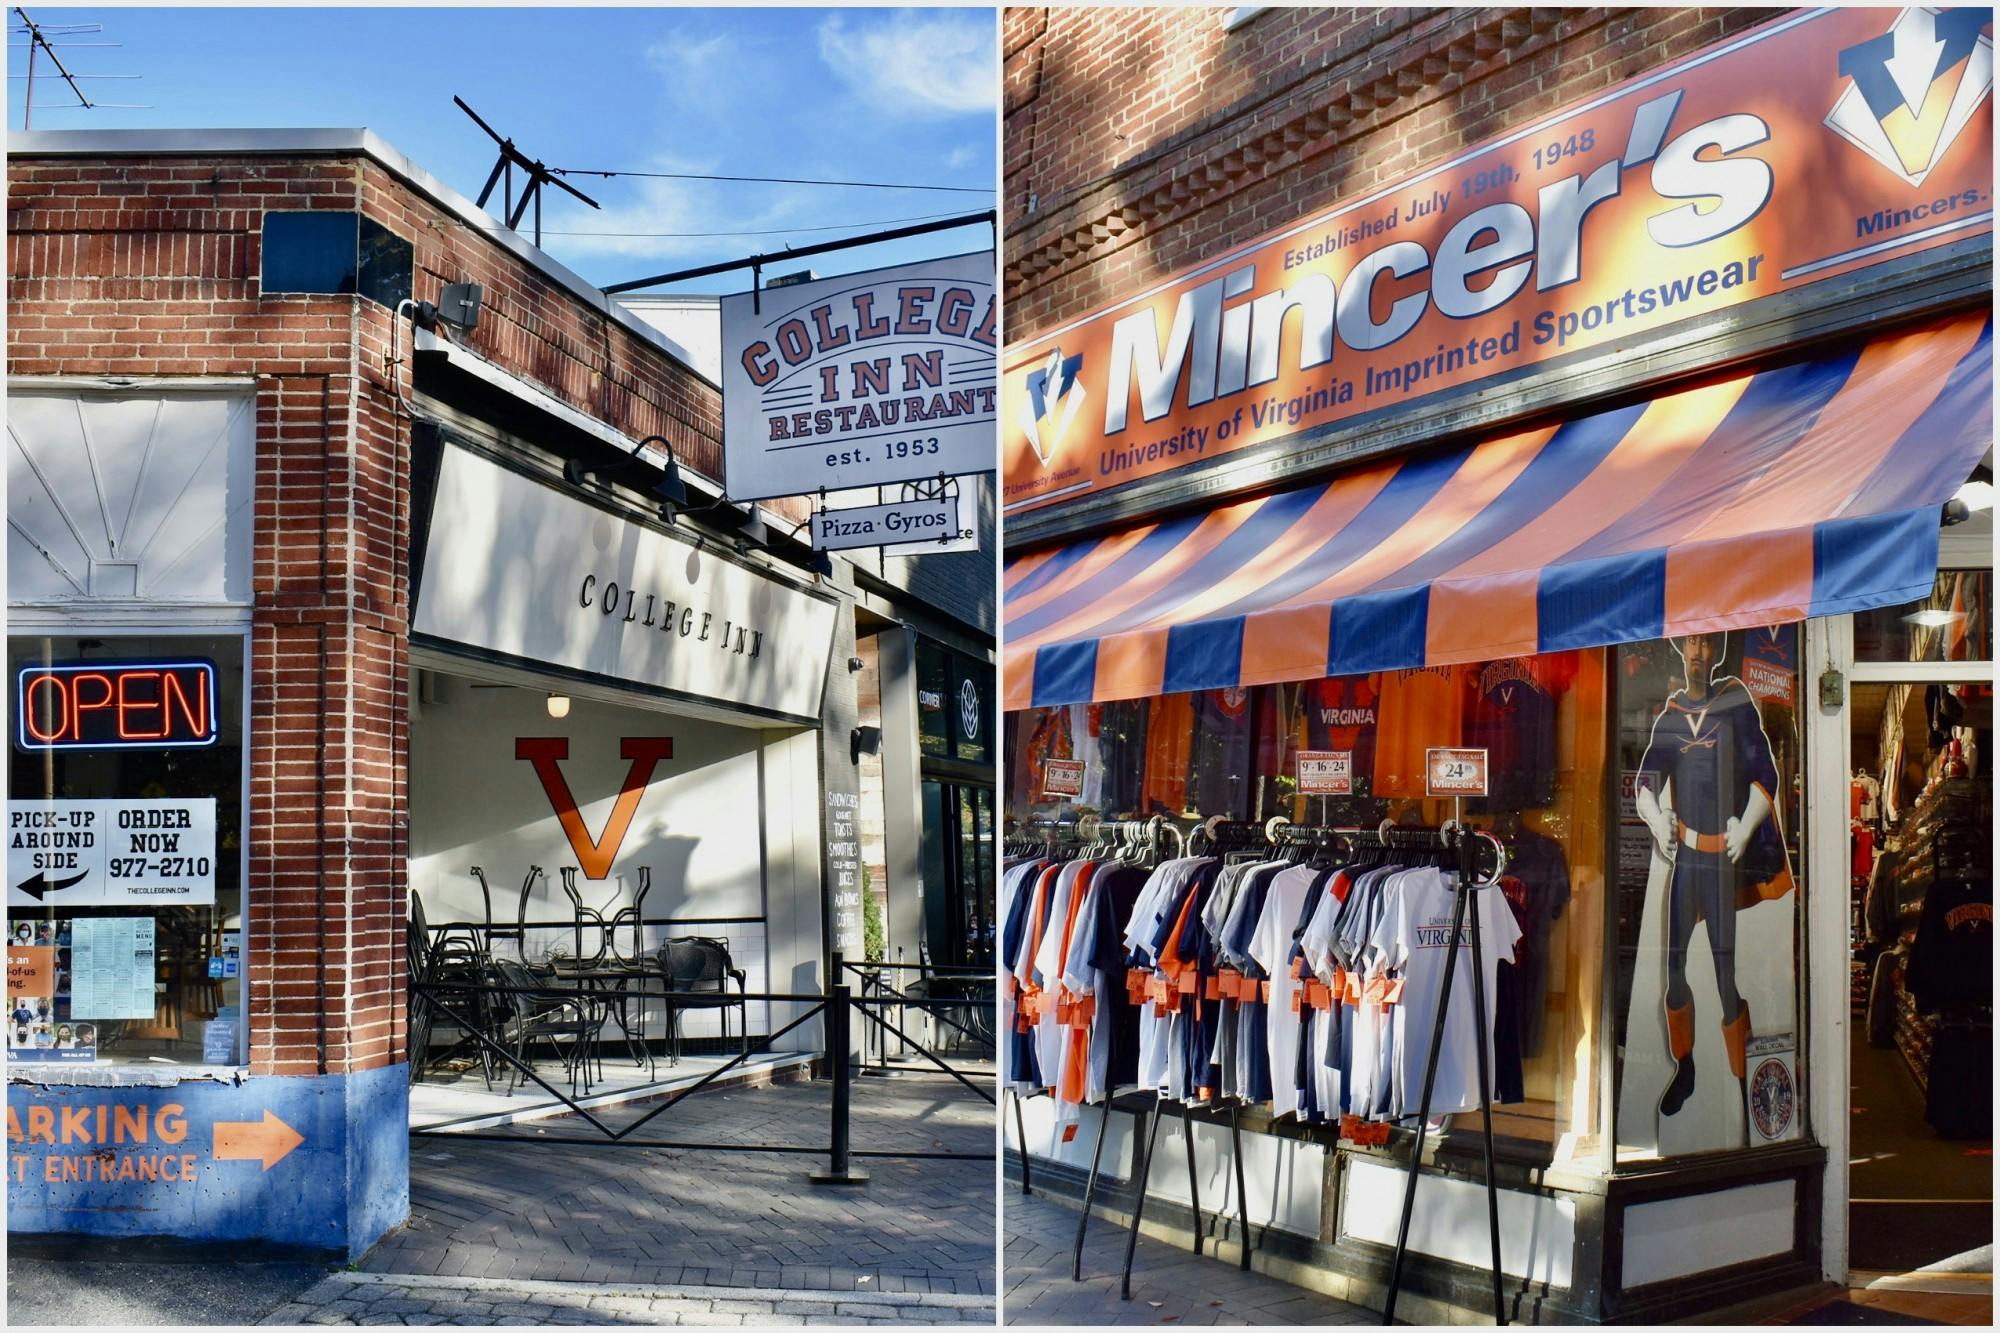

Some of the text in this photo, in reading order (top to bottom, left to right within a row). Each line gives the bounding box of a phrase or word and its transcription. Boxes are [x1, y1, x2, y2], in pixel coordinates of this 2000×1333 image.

[1283, 128, 1596, 271] Established July 19th, 1948
[1857, 187, 1993, 237] Mincers.
[1104, 89, 1775, 436] Mincer's
[820, 350, 943, 402] INN
[1101, 251, 1765, 475] University of Virginia Imprinted Sportswear
[769, 386, 996, 441] RESTAURANT
[826, 437, 940, 467] est. 1953
[1011, 476, 1048, 494] University
[1051, 467, 1081, 482] Avenue
[821, 511, 947, 538] Pizza Gyros
[579, 574, 763, 659] COLLEGE INN
[1748, 681, 1790, 700] CHAMPIONS
[1749, 667, 1791, 690] NATIONAL
[26, 671, 206, 741] OPEN
[1301, 779, 1349, 788] Mincer's
[1432, 780, 1484, 789] Mincer's
[118, 809, 192, 829] ORDER
[515, 732, 673, 880] V
[11, 811, 96, 829] PICK-UP
[11, 831, 95, 849] AROUND
[130, 833, 179, 854] NOW
[33, 852, 78, 869] SIDE
[109, 857, 210, 878] 977-2710
[126, 886, 191, 895] THECOLLEGEINN.COM
[16, 956, 29, 965] an
[45, 1155, 198, 1182] ENTRANCE
